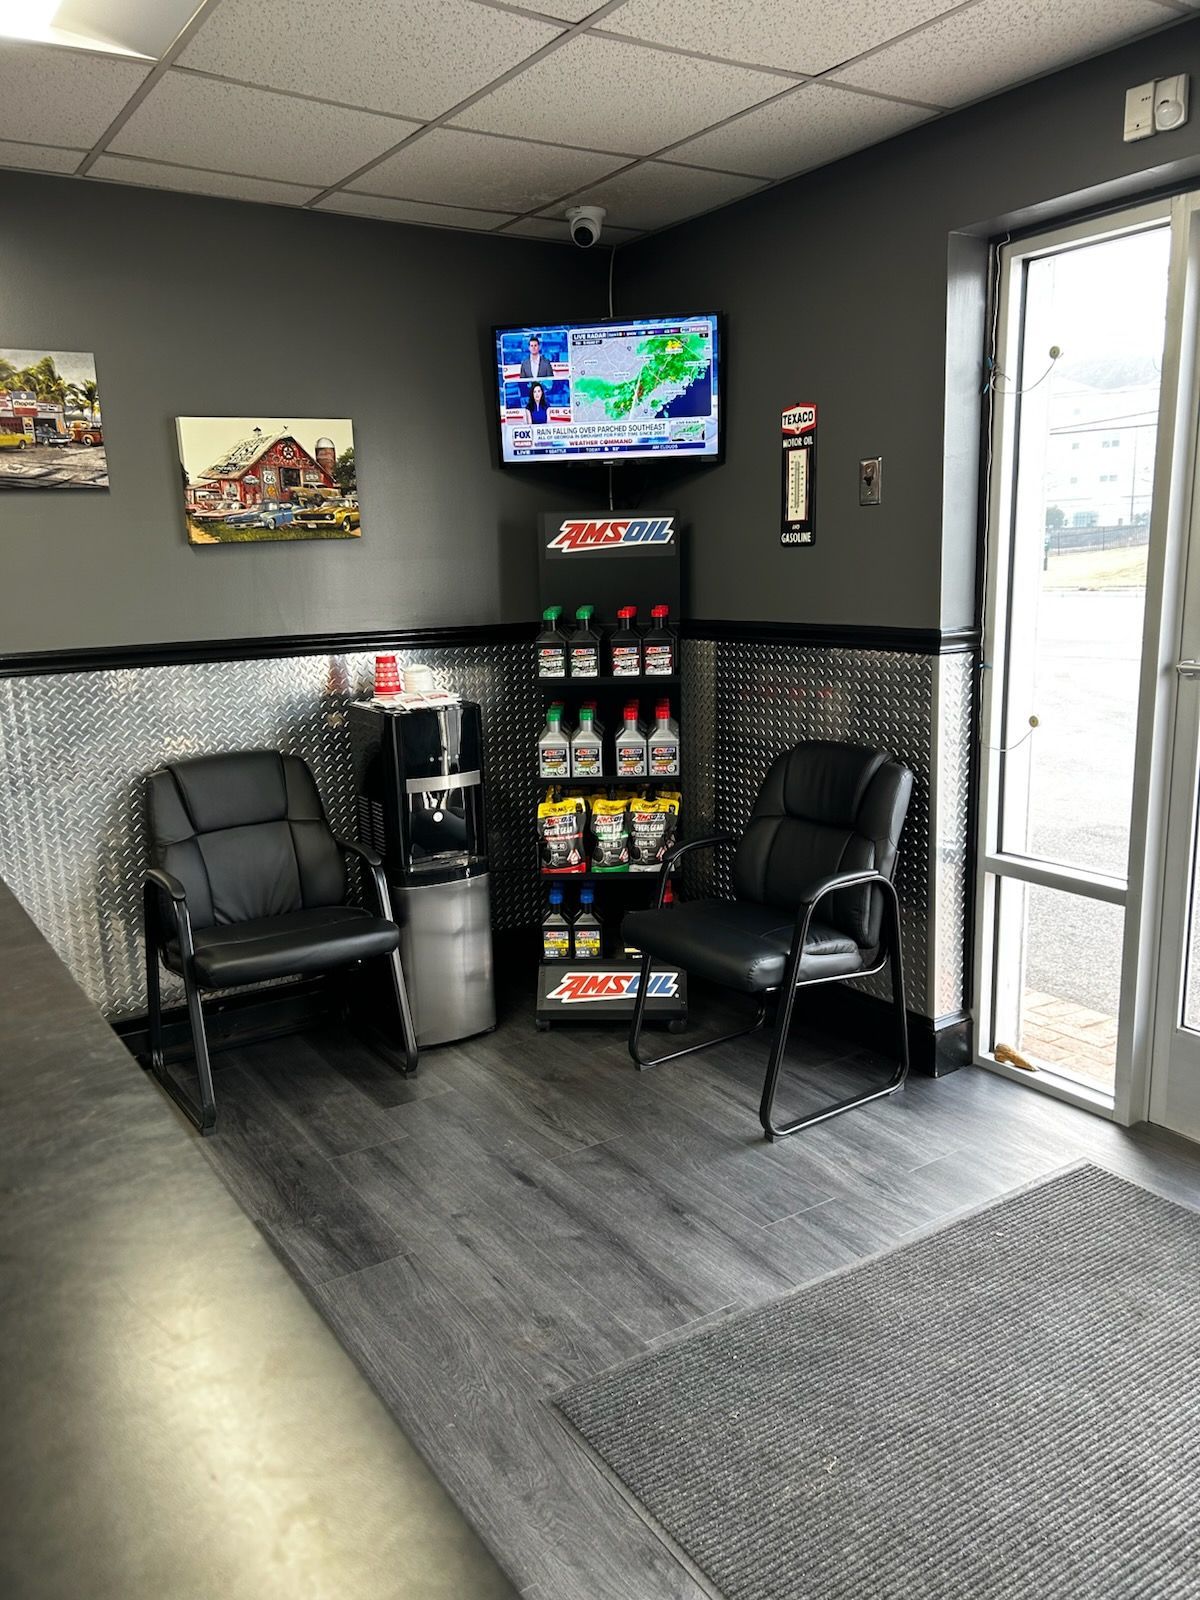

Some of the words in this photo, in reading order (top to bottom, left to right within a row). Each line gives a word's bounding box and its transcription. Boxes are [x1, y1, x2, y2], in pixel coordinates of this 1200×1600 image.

[782, 410, 814, 425] TEXACO
[598, 424, 627, 433] PARCHED
[514, 431, 530, 439] FOX
[783, 437, 802, 448] MOTOR
[804, 436, 814, 445] OIL
[553, 520, 672, 550] AMSOIL
[781, 532, 811, 543] GASOLINE
[636, 814, 664, 822] AMSOIL
[555, 974, 676, 1000] AMSOIL
